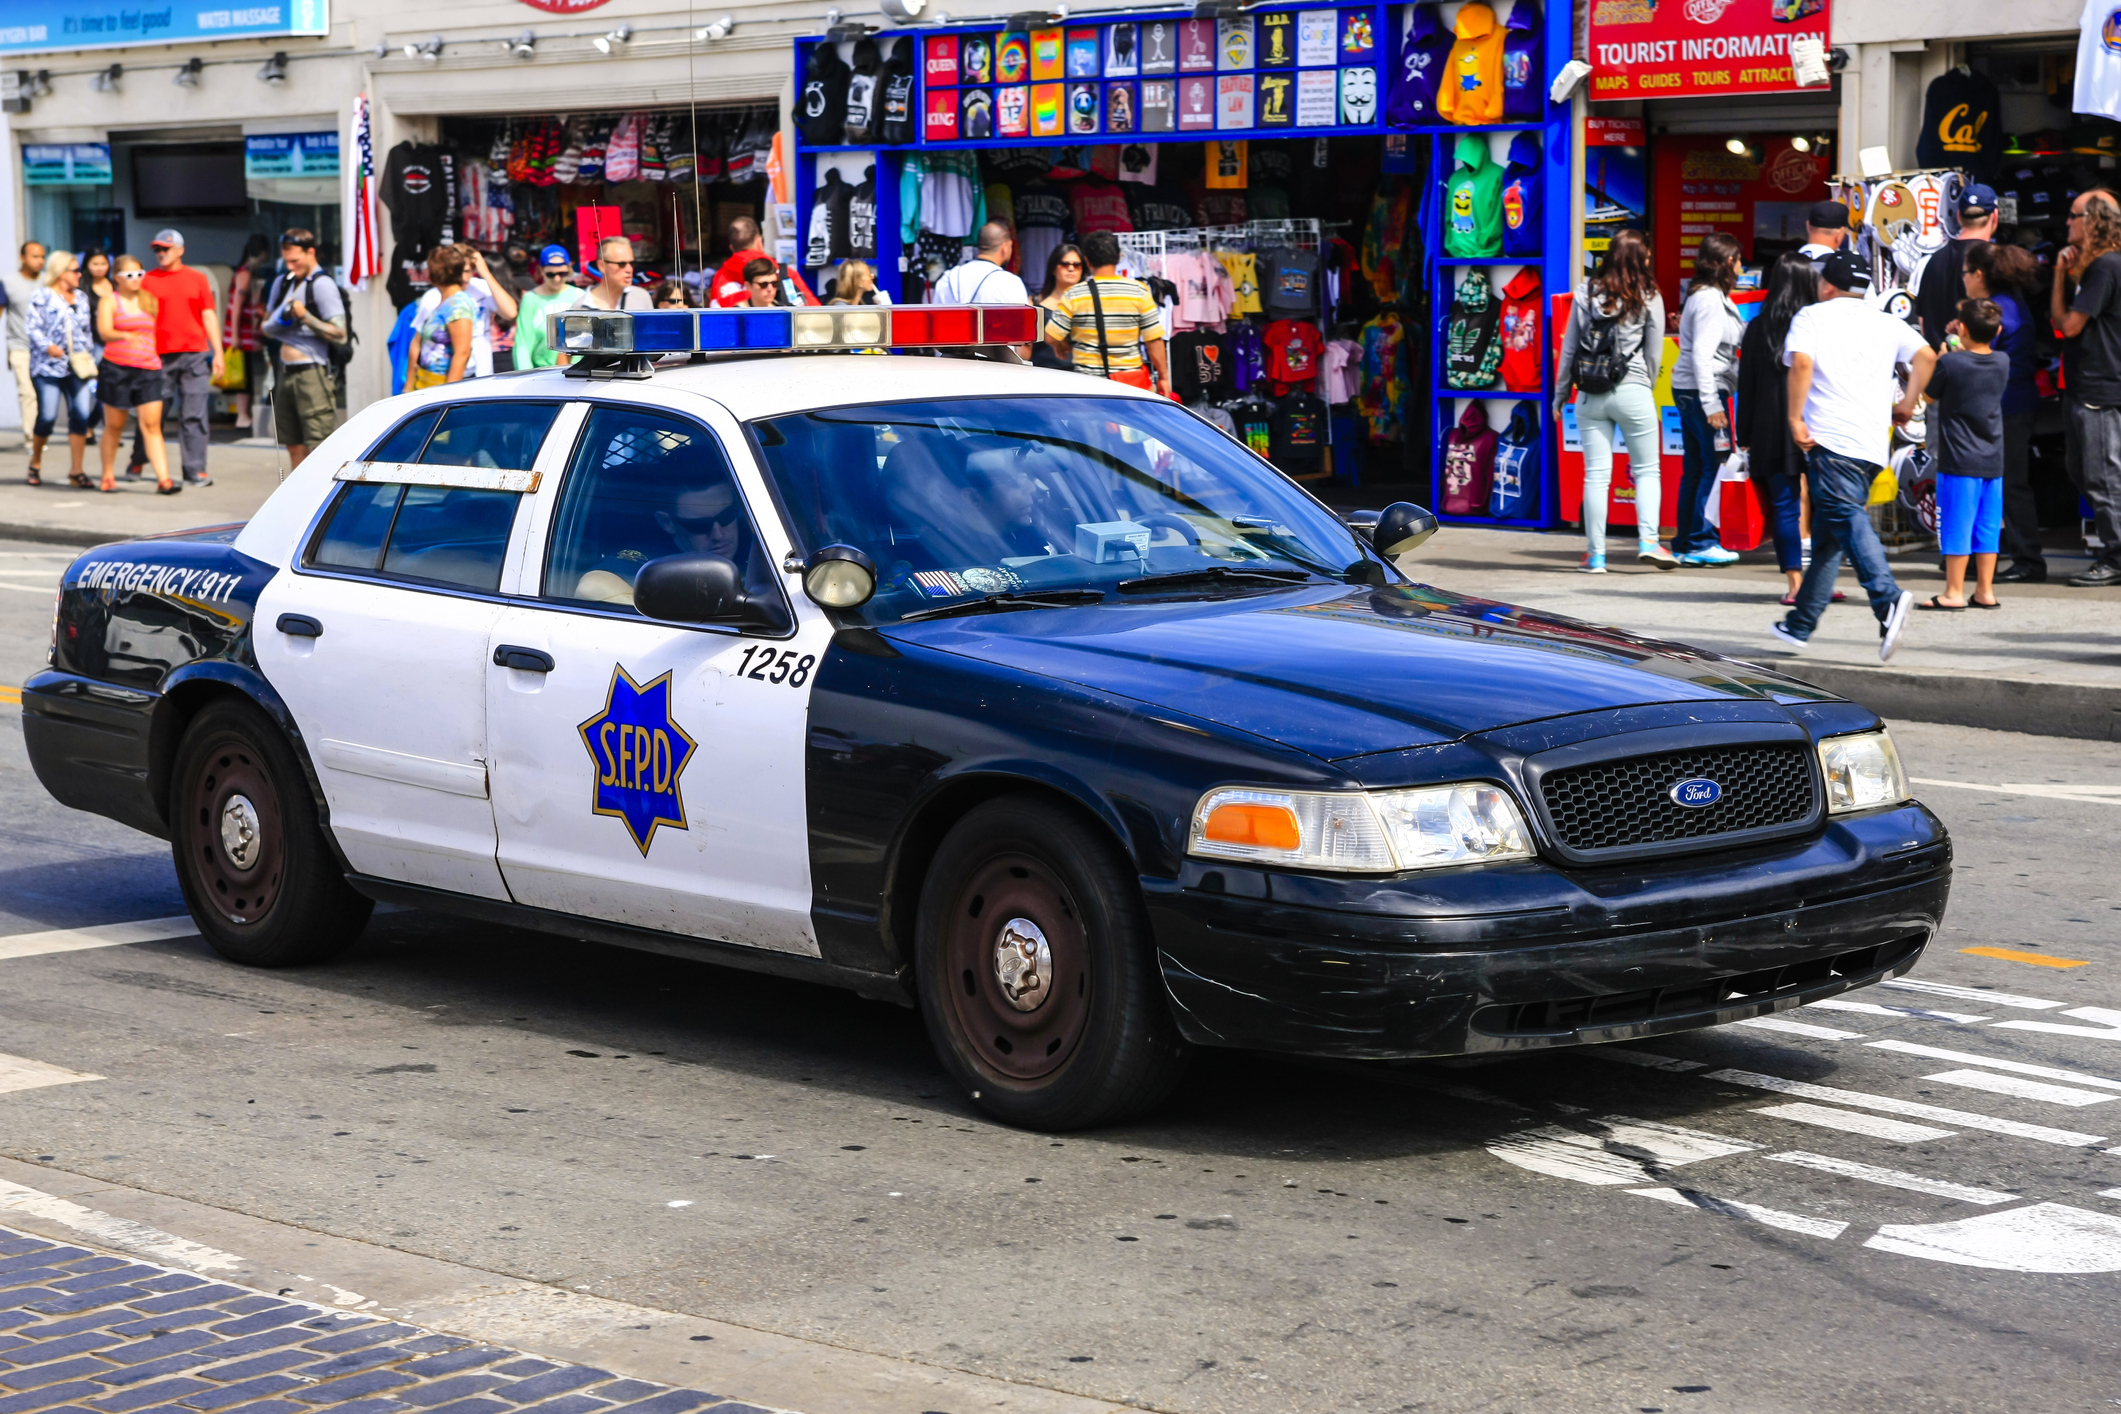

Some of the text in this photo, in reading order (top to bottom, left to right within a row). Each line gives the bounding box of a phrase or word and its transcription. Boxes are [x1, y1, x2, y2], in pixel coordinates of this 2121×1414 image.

[81, 15, 104, 32] time
[106, 15, 117, 31] to
[120, 9, 140, 30] feel
[142, 6, 171, 34] good
[197, 12, 230, 29] WATER
[232, 7, 281, 26] MASSAGE
[29, 25, 47, 42] BAR
[1301, 25, 1335, 45] Google
[1597, 40, 1677, 65] TOURIST
[927, 58, 957, 74] QUEEN
[1596, 75, 1629, 90] MAPS
[1639, 73, 1682, 89] GUIDES
[1692, 70, 1731, 86] TOURS
[927, 112, 955, 126] KING
[1001, 107, 1019, 125] BE
[1588, 119, 1641, 130] BUY TICKETS
[1938, 103, 1988, 144] Cal
[1604, 134, 1626, 142] HERE
[1772, 163, 1818, 181] OFFICIAL
[1695, 202, 1737, 210] COMMENTARY
[77, 561, 243, 603] EMERGENCY 911
[736, 645, 816, 688] 1258
[600, 721, 673, 795] S.F.P.D.
[1685, 784, 1712, 801] Ford
